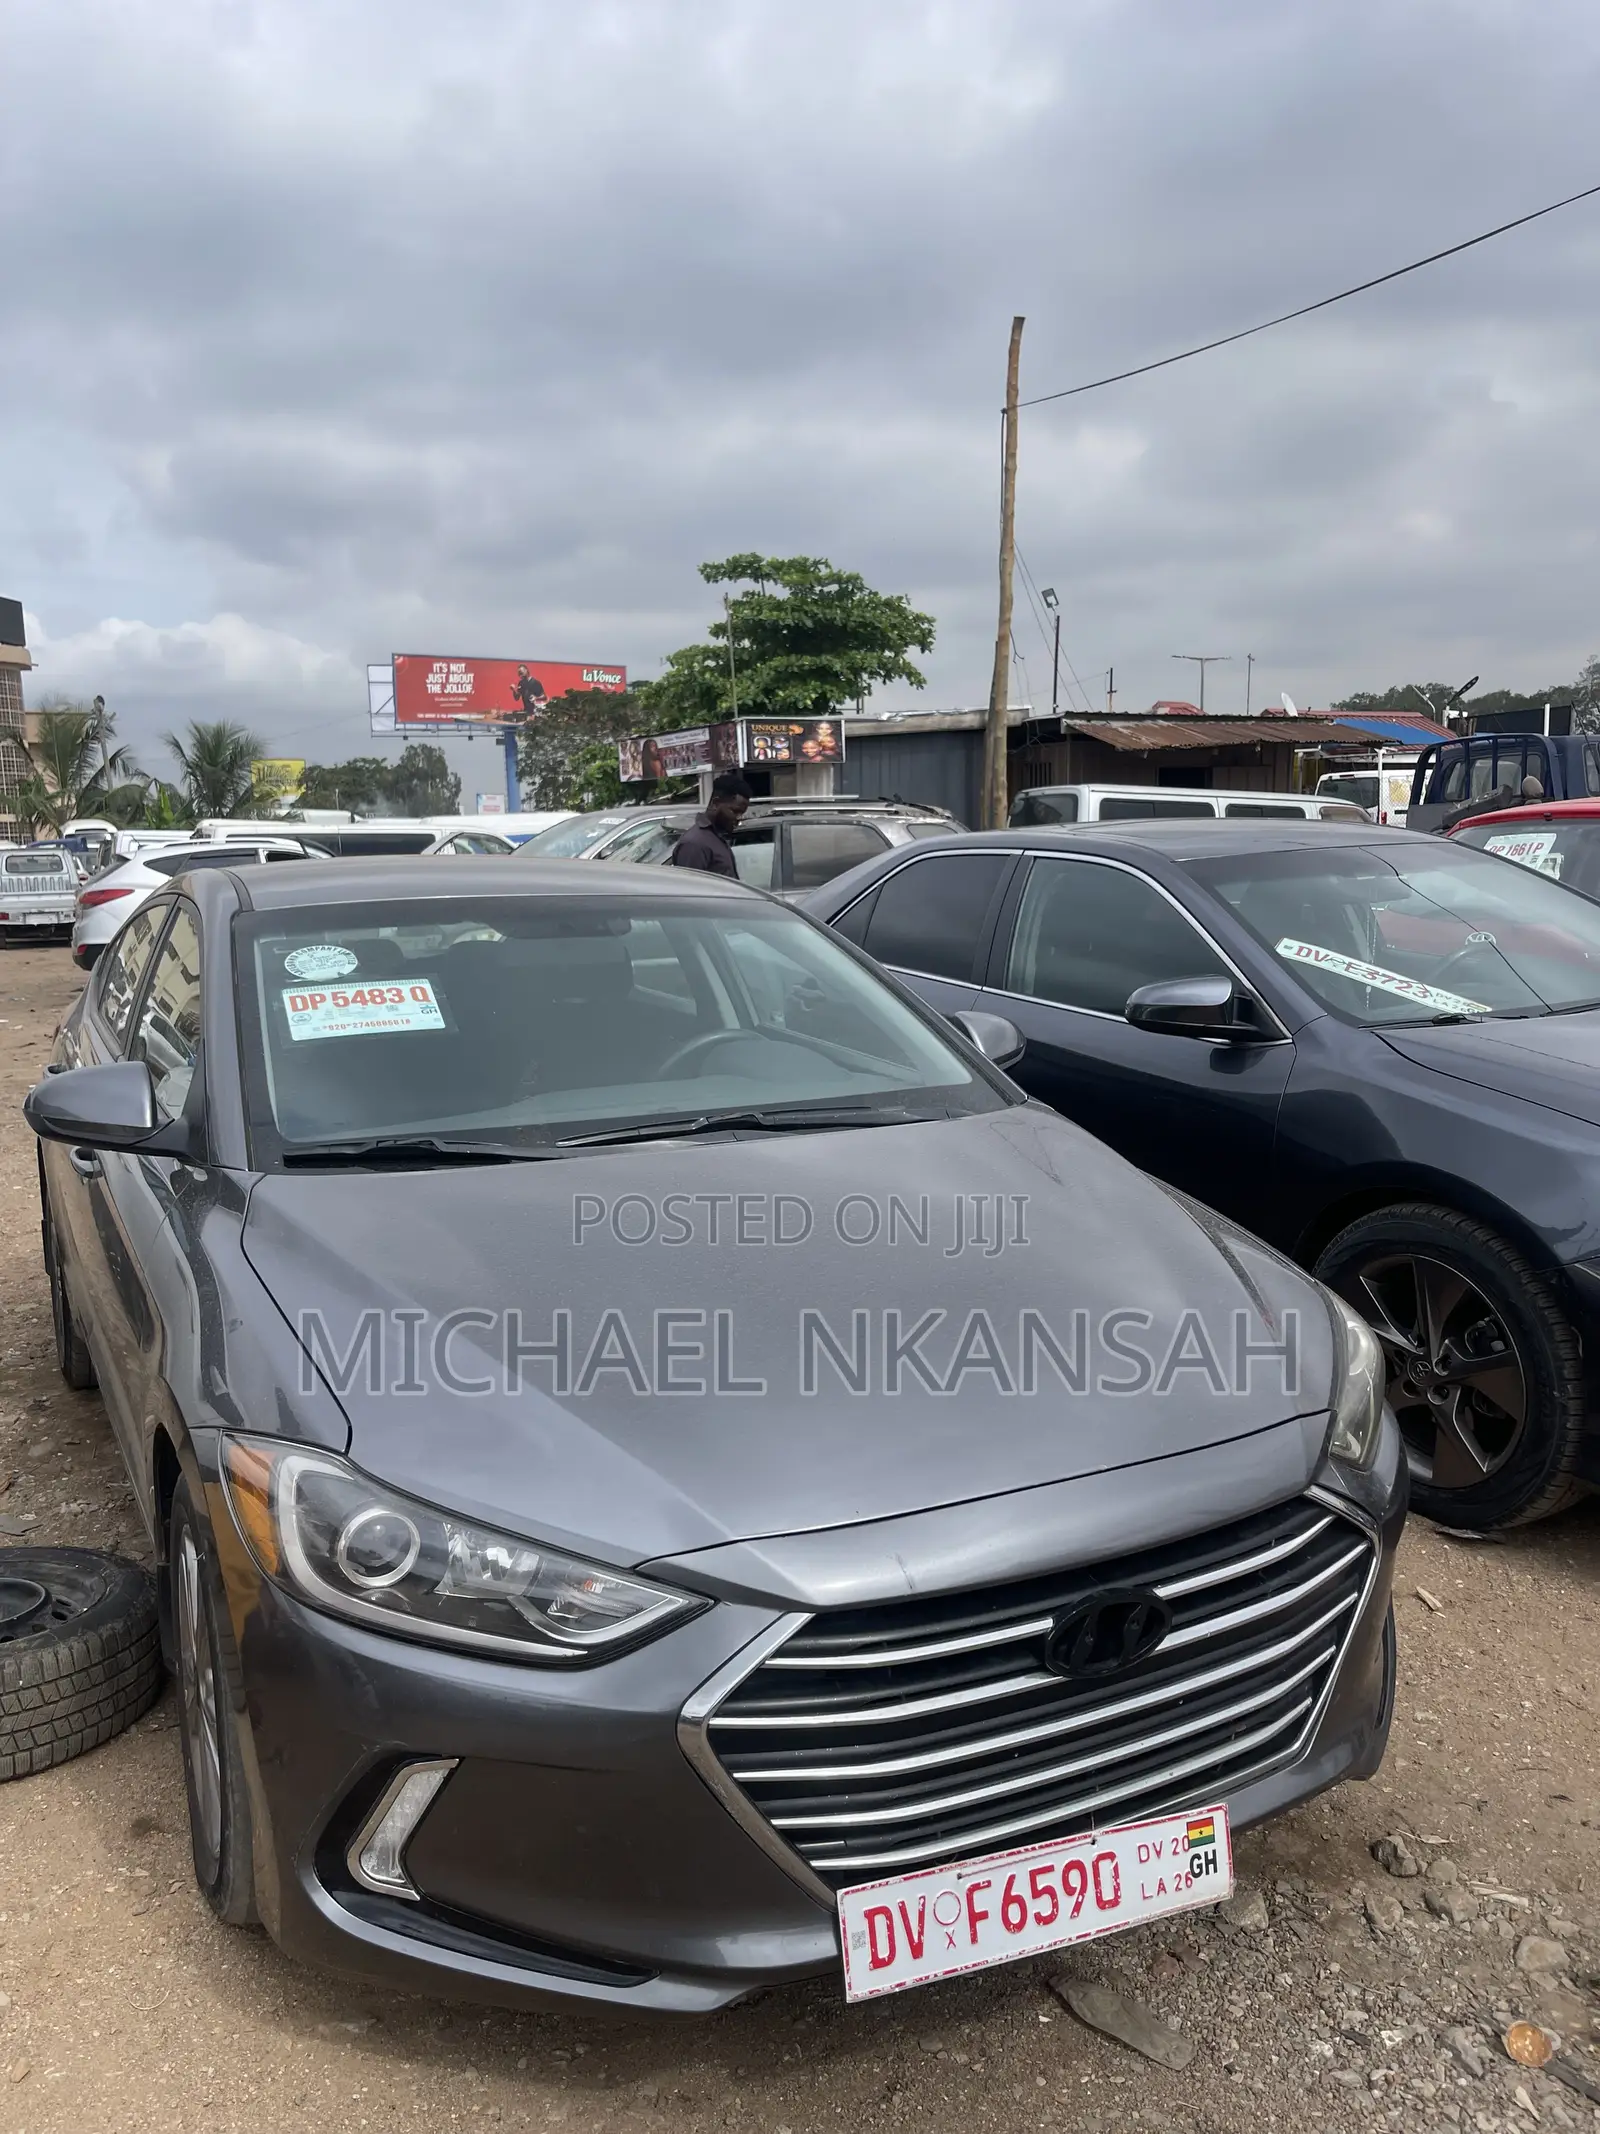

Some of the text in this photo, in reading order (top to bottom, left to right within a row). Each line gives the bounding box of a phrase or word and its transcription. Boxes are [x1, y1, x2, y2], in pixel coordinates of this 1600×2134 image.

[433, 662, 466, 673] IT'S NOT
[426, 674, 475, 684] JUST ABOUT
[426, 684, 442, 694] THE
[751, 724, 788, 732] UNIQUE
[1506, 843, 1534, 857] 1661
[1533, 842, 1545, 854] P
[296, 946, 338, 956] COMPANY
[1293, 945, 1330, 963] DV
[288, 993, 327, 1013] DP
[331, 987, 406, 1009] 5483
[409, 986, 432, 1003] Q
[1137, 1834, 1190, 1864] DV 20
[1189, 1848, 1218, 1879] GH
[1140, 1870, 1193, 1900] LA 26
[863, 1850, 1122, 1971] DV F6590
